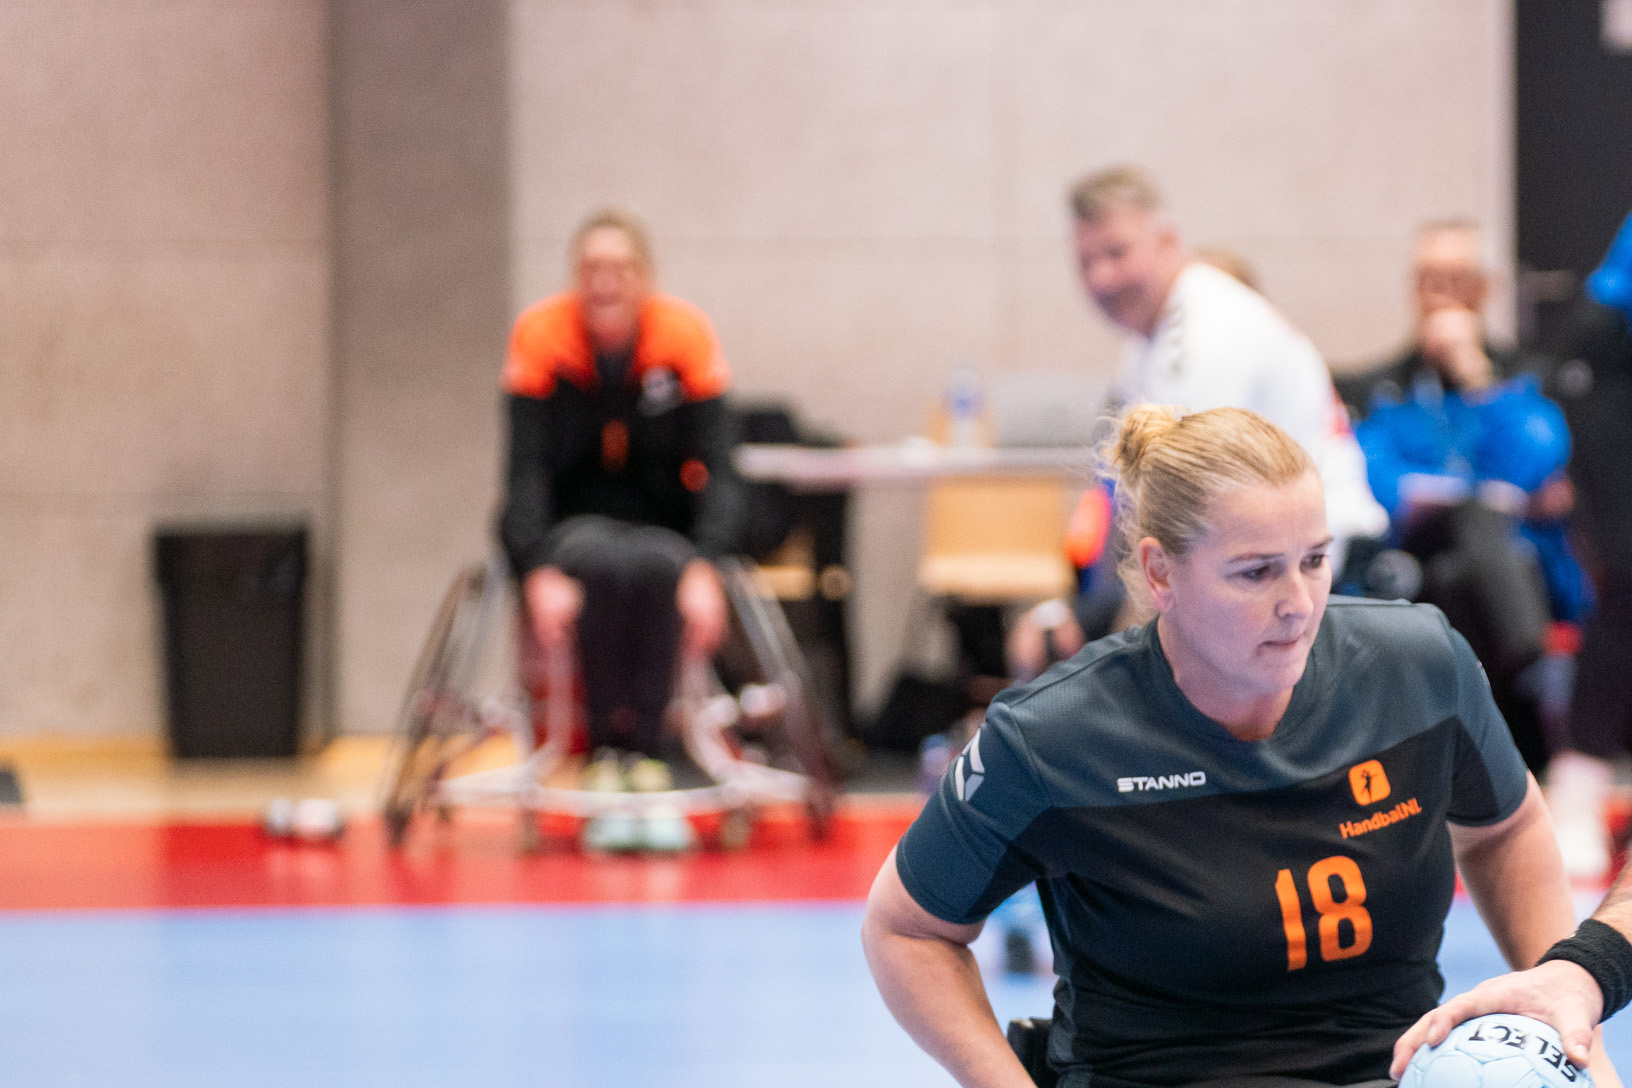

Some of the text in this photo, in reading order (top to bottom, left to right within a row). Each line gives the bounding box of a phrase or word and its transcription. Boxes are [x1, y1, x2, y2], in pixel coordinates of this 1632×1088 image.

[1116, 771, 1206, 793] STANNO
[1275, 855, 1374, 972] 18
[1468, 1023, 1582, 1083] SELECT
